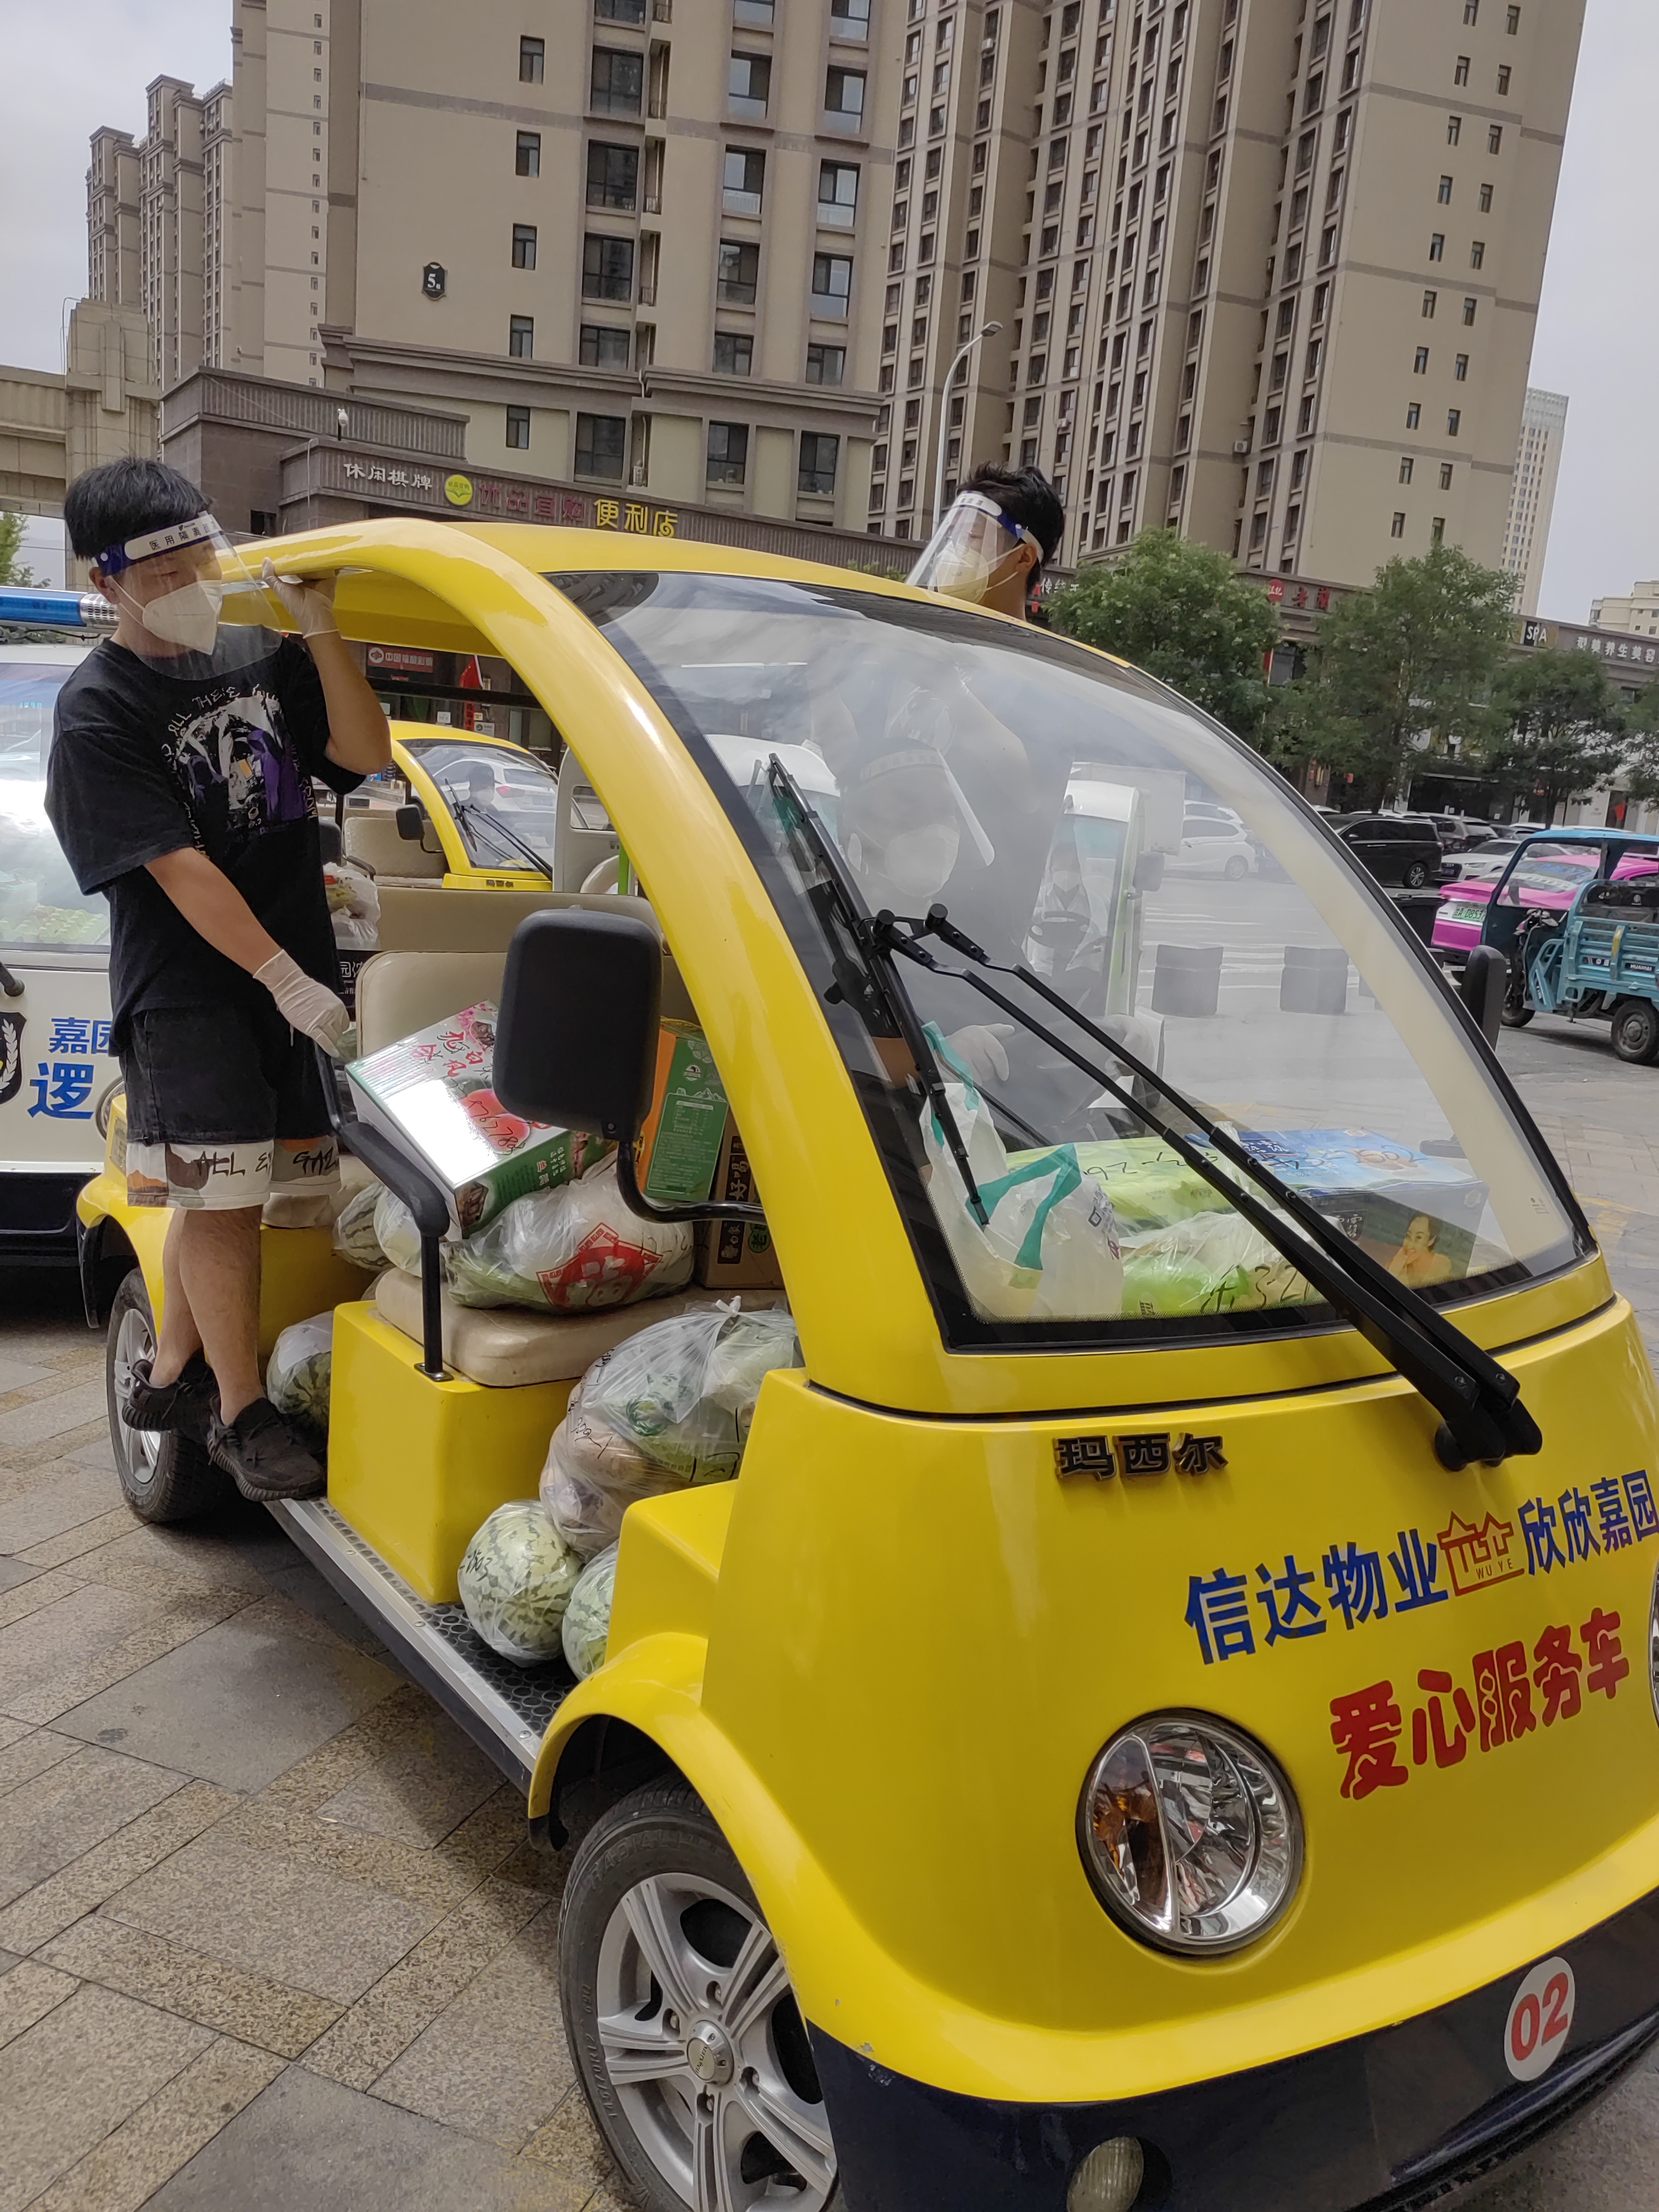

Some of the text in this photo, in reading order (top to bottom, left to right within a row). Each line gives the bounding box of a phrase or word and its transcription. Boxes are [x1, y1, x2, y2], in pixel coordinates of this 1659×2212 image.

[344, 463, 432, 491] 休闲棋牌
[594, 499, 679, 537] 便利店
[1526, 625, 1547, 643] SPA
[27, 1062, 95, 1120] 逻
[1054, 1432, 1228, 1481] 玛西尔
[1184, 1469, 1658, 1664] 信达物业 欣欣嘉园
[1476, 1558, 1513, 1580] WU YE
[1330, 1607, 1629, 1800] 爱心服务车
[1511, 1972, 1569, 2062] 02
